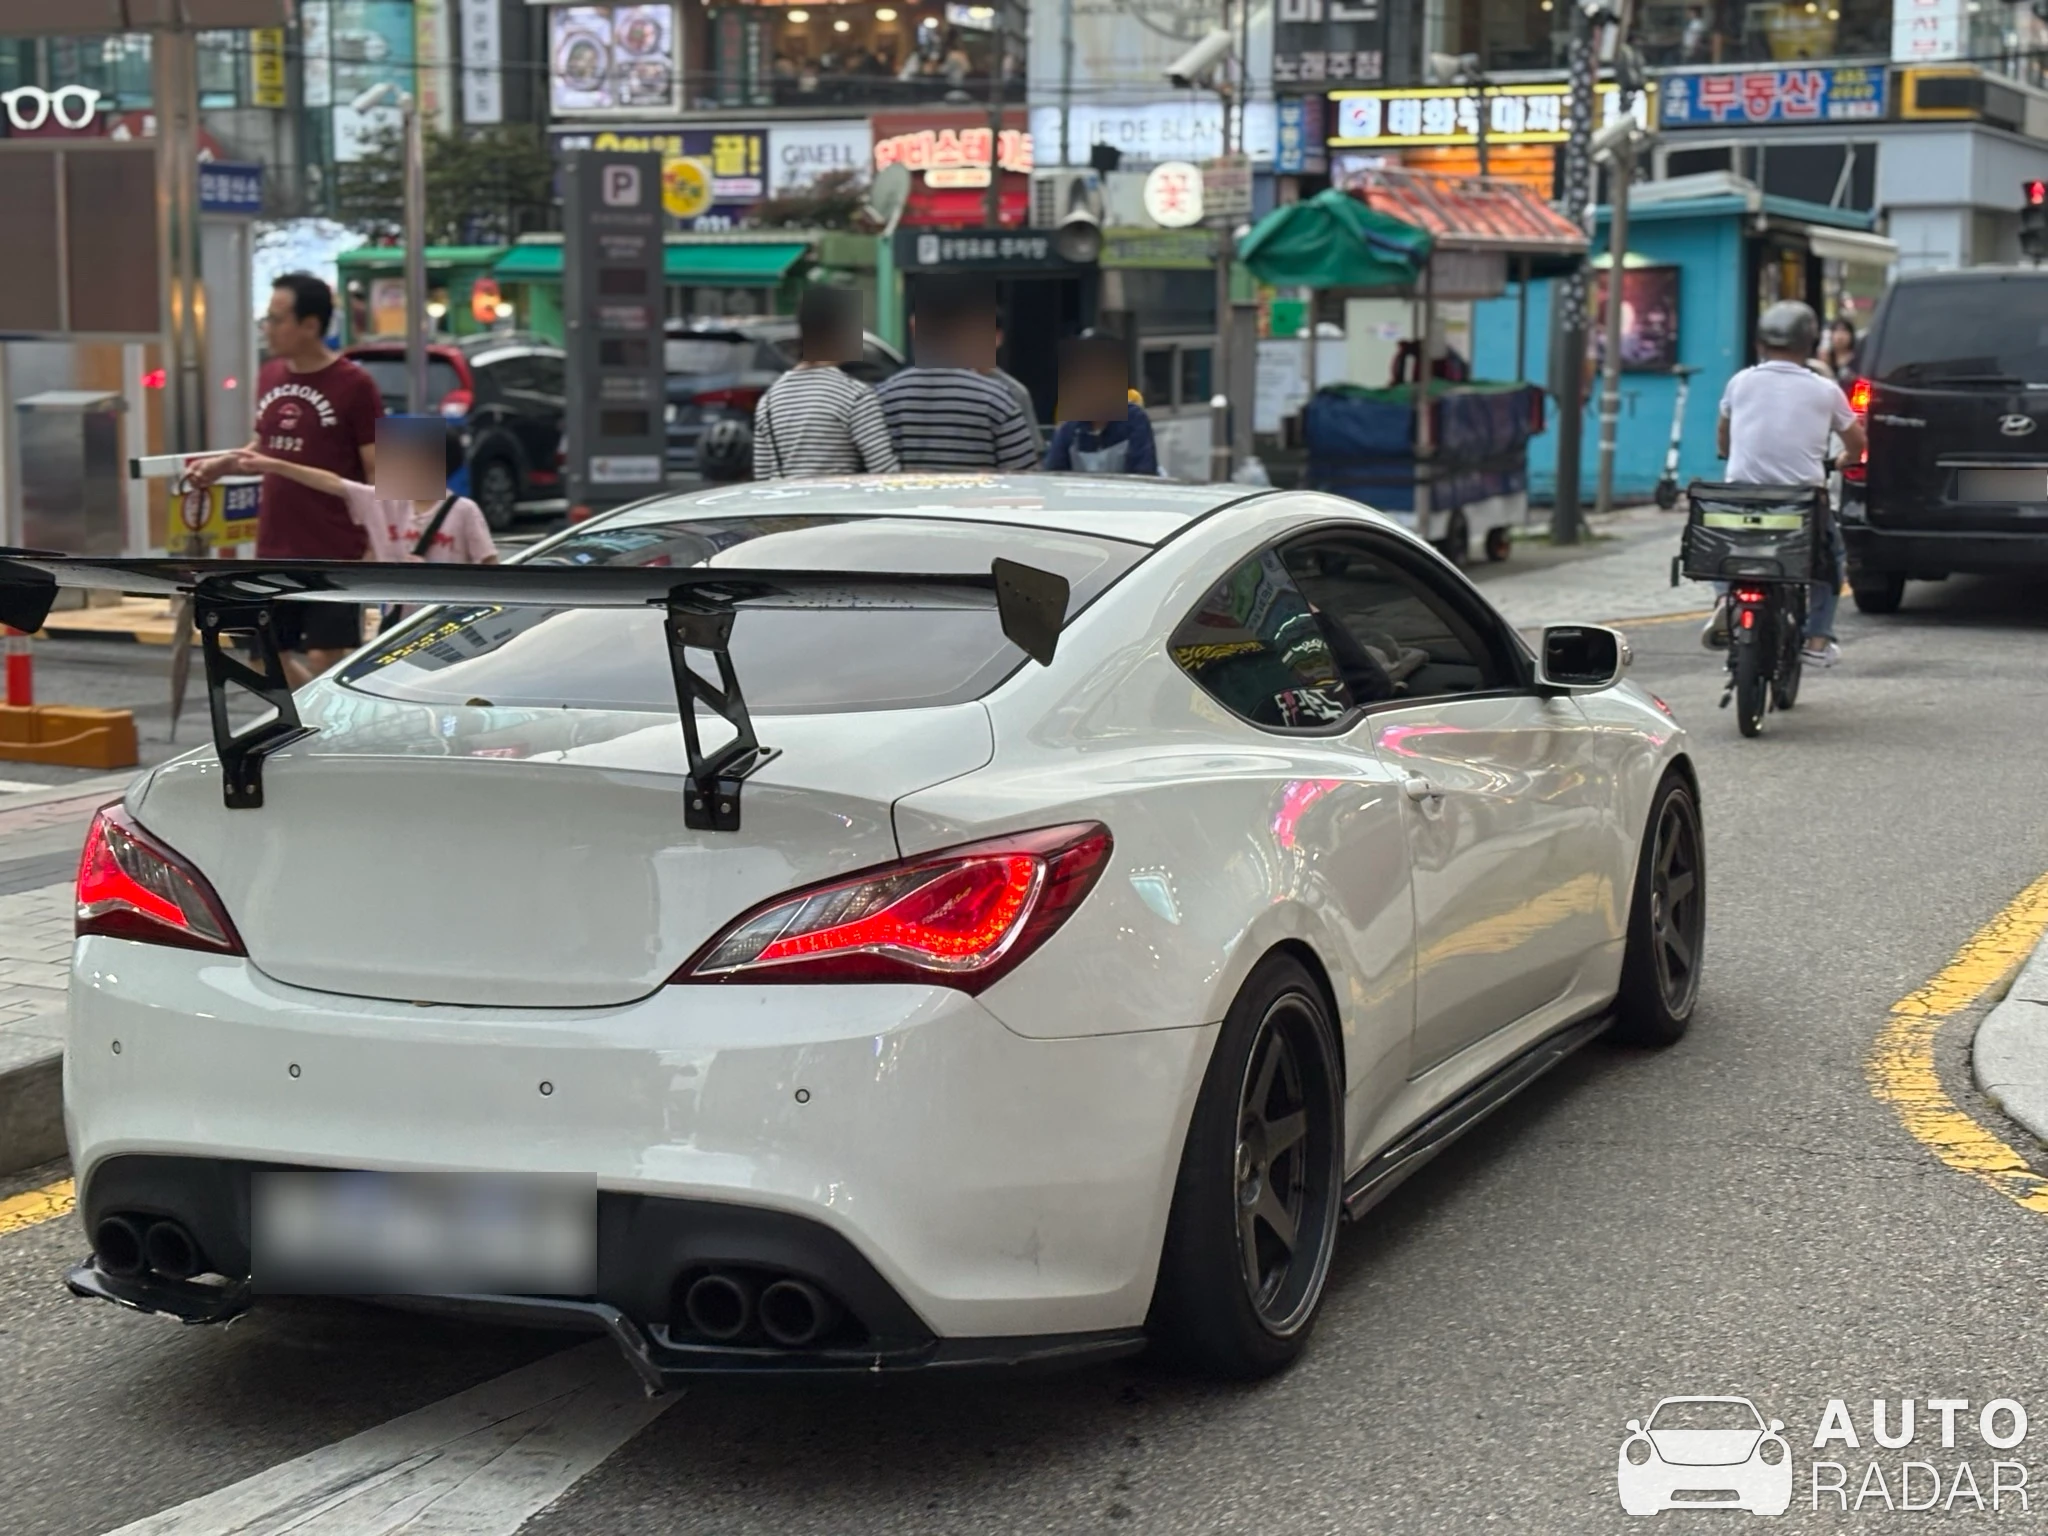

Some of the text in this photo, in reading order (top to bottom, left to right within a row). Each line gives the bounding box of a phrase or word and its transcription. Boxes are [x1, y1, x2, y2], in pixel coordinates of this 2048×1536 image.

[1274, 50, 1382, 81] 노래주점
[1699, 70, 1826, 121] 부동산
[1120, 120, 1150, 142] DE
[611, 171, 633, 199] P
[999, 237, 1048, 260] 주차장
[268, 435, 304, 452] 1892
